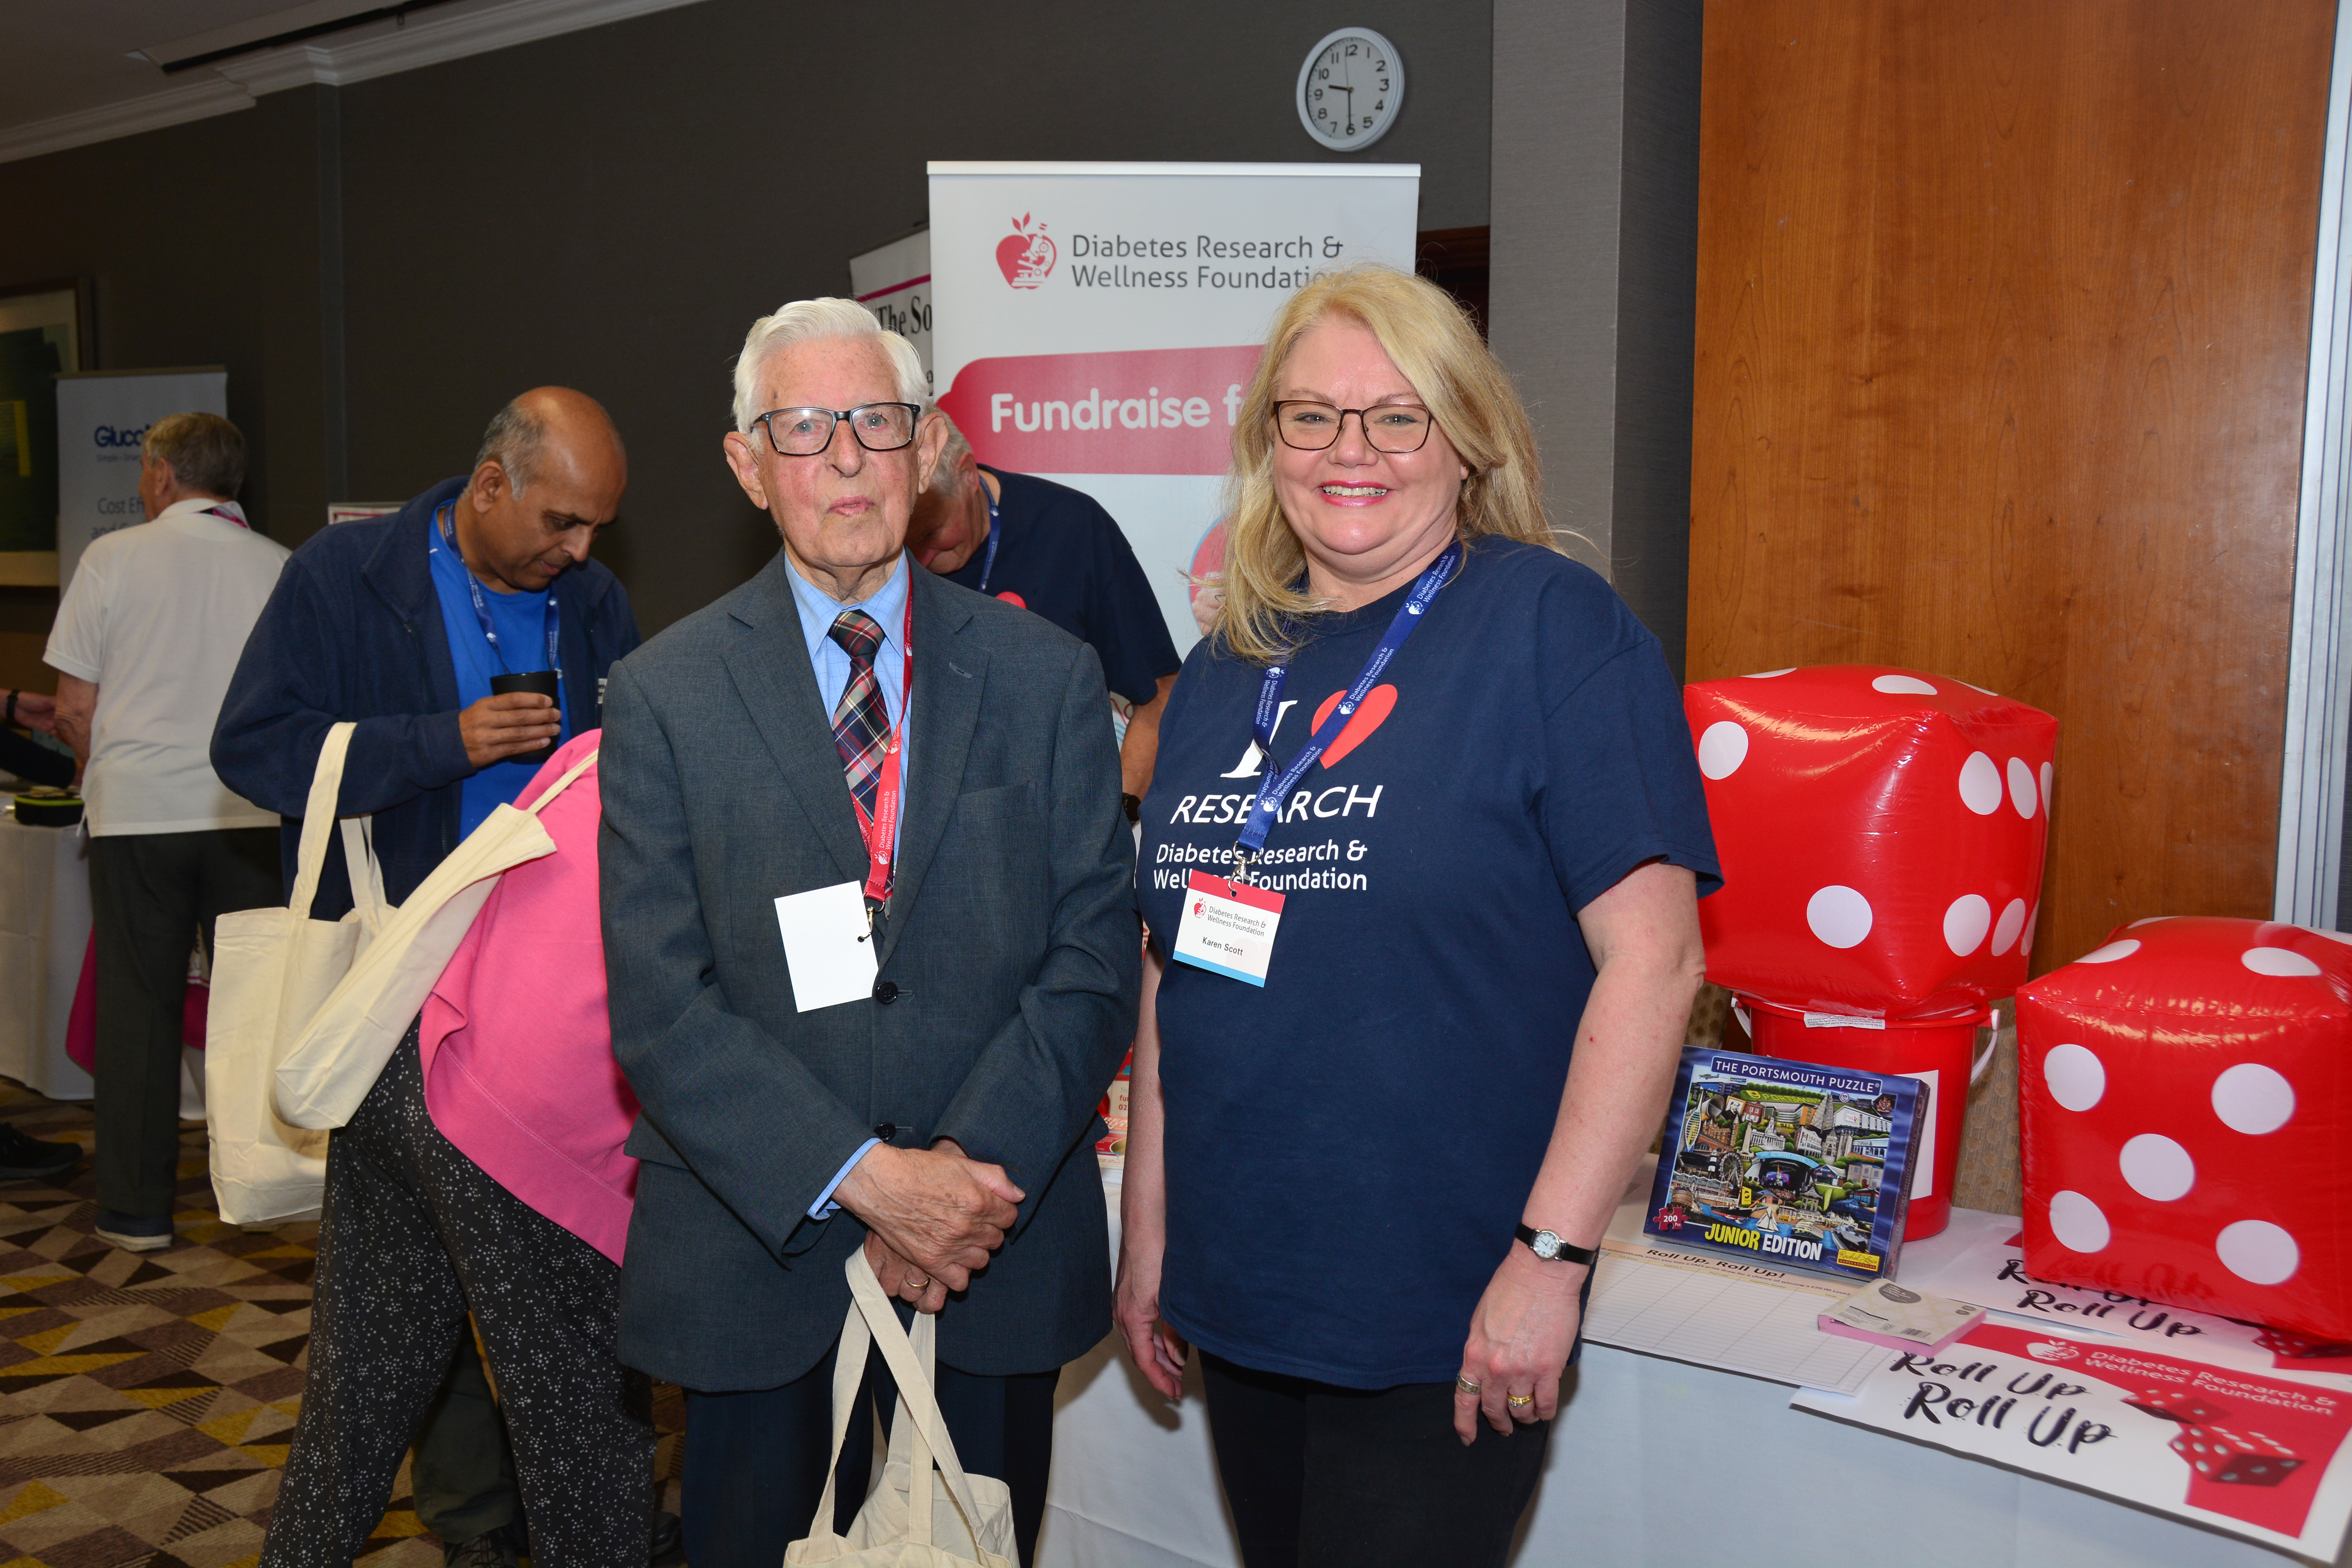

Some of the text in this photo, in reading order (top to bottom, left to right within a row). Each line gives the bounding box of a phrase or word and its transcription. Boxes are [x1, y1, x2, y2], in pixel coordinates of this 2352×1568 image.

[1332, 52, 1339, 64] 11
[1345, 44, 1357, 56] 12
[1367, 47, 1370, 58] 1
[1319, 68, 1329, 80] 10
[1376, 60, 1385, 72] 2
[1314, 89, 1323, 100] 9
[1379, 79, 1389, 91] 3
[1318, 108, 1327, 119] 8
[1375, 100, 1383, 111] 4
[1330, 122, 1337, 132] 7
[1346, 123, 1355, 135] 6
[1363, 116, 1373, 128] 5
[1073, 235, 1343, 258] Diabetes Research &
[1072, 265, 1327, 288] Wellness Foundati
[877, 303, 906, 336] The
[991, 384, 1243, 432] Fundraise f
[98, 497, 125, 514] Cost
[1417, 575, 1436, 599] Diabetes
[1432, 559, 1446, 575] Research
[1423, 555, 1455, 603] Wellness Foundation
[1349, 677, 1368, 699] Diabetes
[1366, 653, 1385, 677] Research
[1355, 649, 1394, 701] Wellness Foundation
[1256, 680, 1270, 724] Wellness Foundation
[1268, 681, 1278, 700] Diabetes
[1263, 700, 1272, 721] Research
[1272, 773, 1293, 795] Diabetes
[1290, 751, 1312, 772] Research
[1277, 748, 1323, 797] Wellness Foundation
[1170, 785, 1383, 824] RESERCH
[885, 790, 897, 849] Wellness Foundation
[1156, 843, 1244, 865] Diabetes
[1347, 840, 1367, 861] &
[1249, 867, 1367, 891] Foundation
[1208, 915, 1264, 937] Wellness Foundation
[1209, 906, 1233, 919] Diabetes
[1234, 913, 1259, 927] Research
[1202, 936, 1243, 956] Karen Scott
[1716, 1061, 1737, 1073] THE
[1742, 1065, 1825, 1085] PORTSMOUTH
[1763, 1093, 1822, 1103] PORTSMOUTH
[1607, 1249, 1643, 1257] automatically
[1705, 1223, 1822, 1261] JUNIOR EDITION
[1647, 1250, 1786, 1278] Roll Up, Roll Up!
[1839, 1251, 1878, 1264] Rachel Lowe
[2015, 1289, 2208, 1337] Roll Up
[1889, 1351, 2092, 1399] Roll Up
[2085, 1358, 2334, 1415] Wellness Foundation
[2091, 1351, 2338, 1406] Diabetes Research &
[1904, 1381, 2118, 1454] Roll Up
